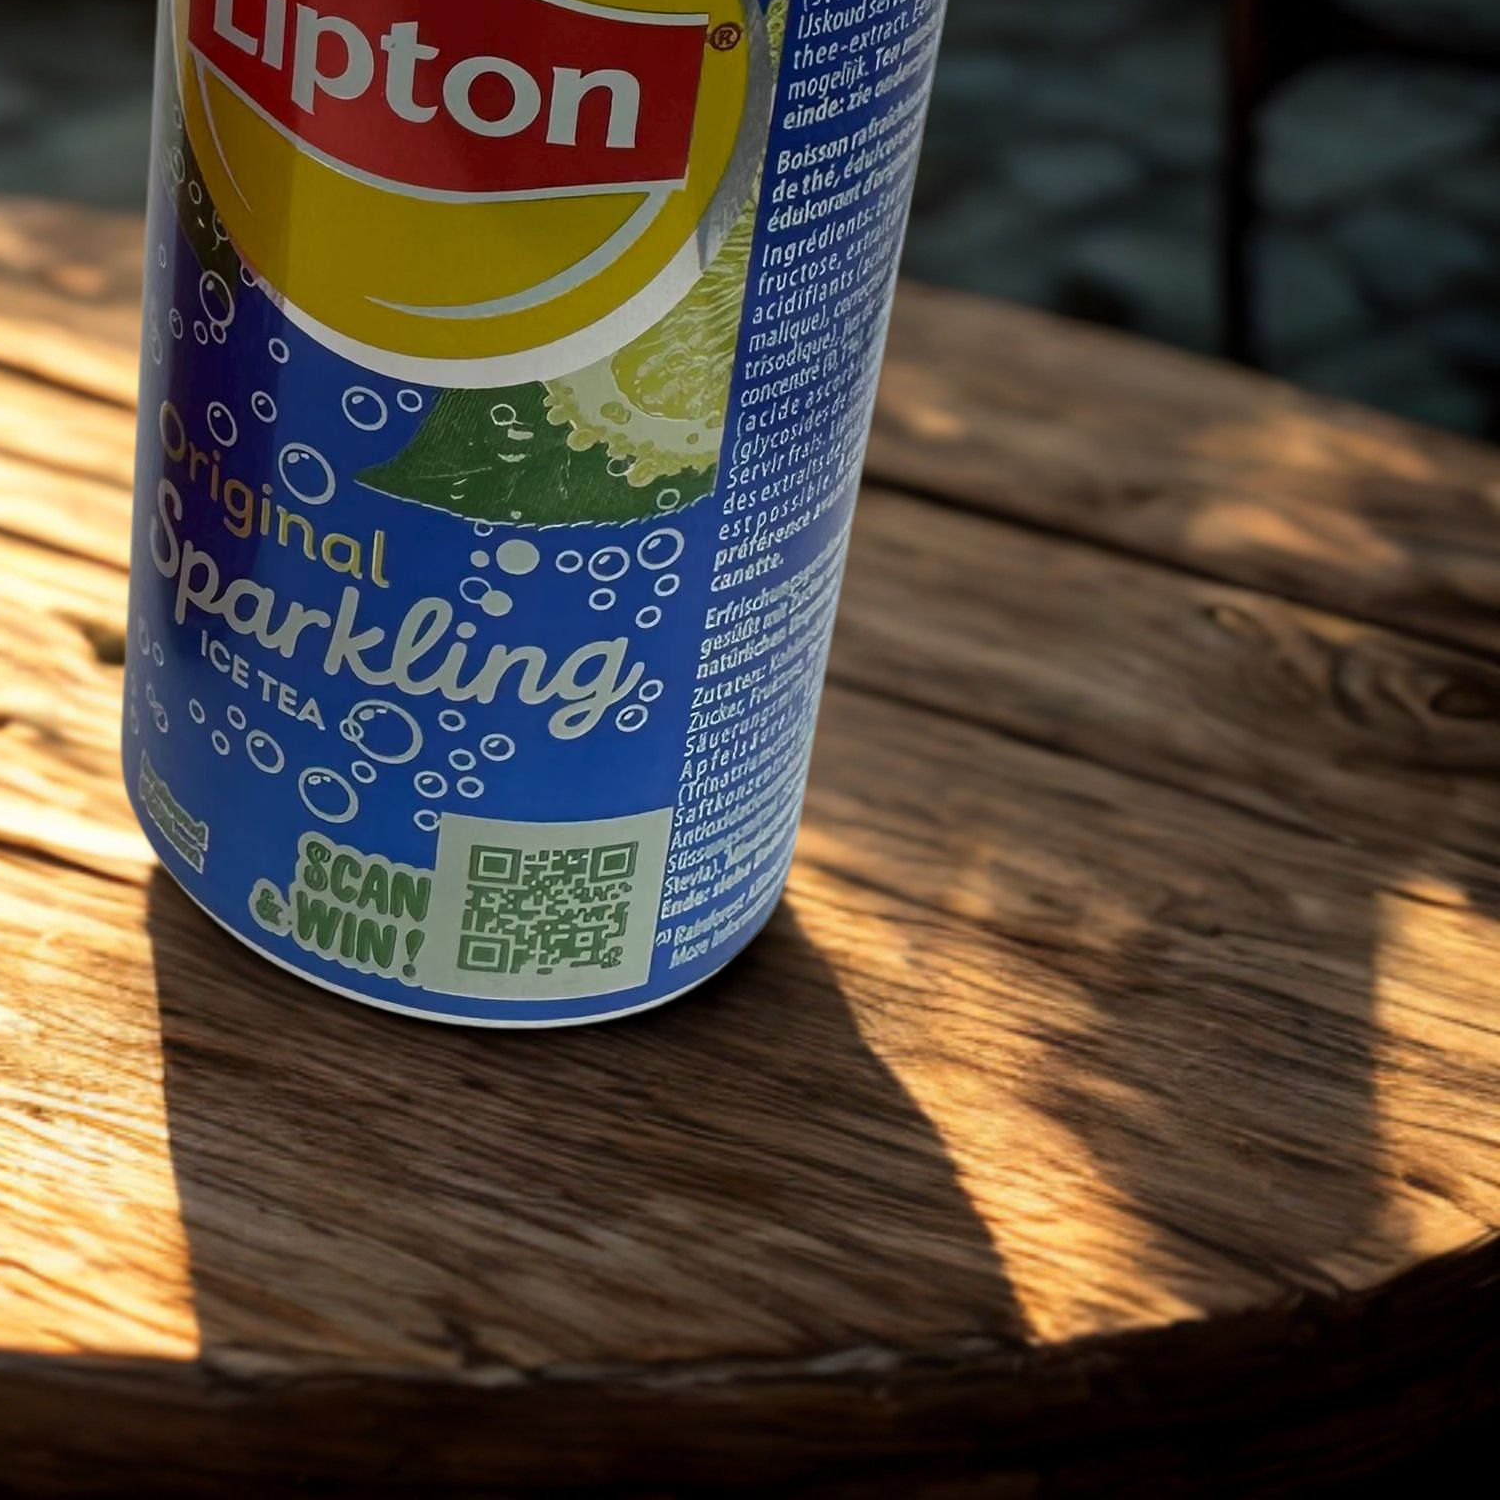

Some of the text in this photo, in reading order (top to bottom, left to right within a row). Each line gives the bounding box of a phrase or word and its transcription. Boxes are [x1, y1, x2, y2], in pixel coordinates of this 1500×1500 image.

[776, 136, 849, 175] Boisson
[772, 178, 799, 204] de
[757, 252, 842, 297] fructose,
[752, 270, 854, 325] acidifiants
[736, 397, 800, 439] (acide
[726, 454, 786, 490] Servir
[158, 400, 391, 590] Original
[722, 490, 757, 517] des
[717, 516, 753, 542] est
[149, 477, 646, 740] Sparkling
[200, 629, 326, 731] ICE TEA
[302, 839, 432, 924] SCAN
[255, 887, 283, 926] &
